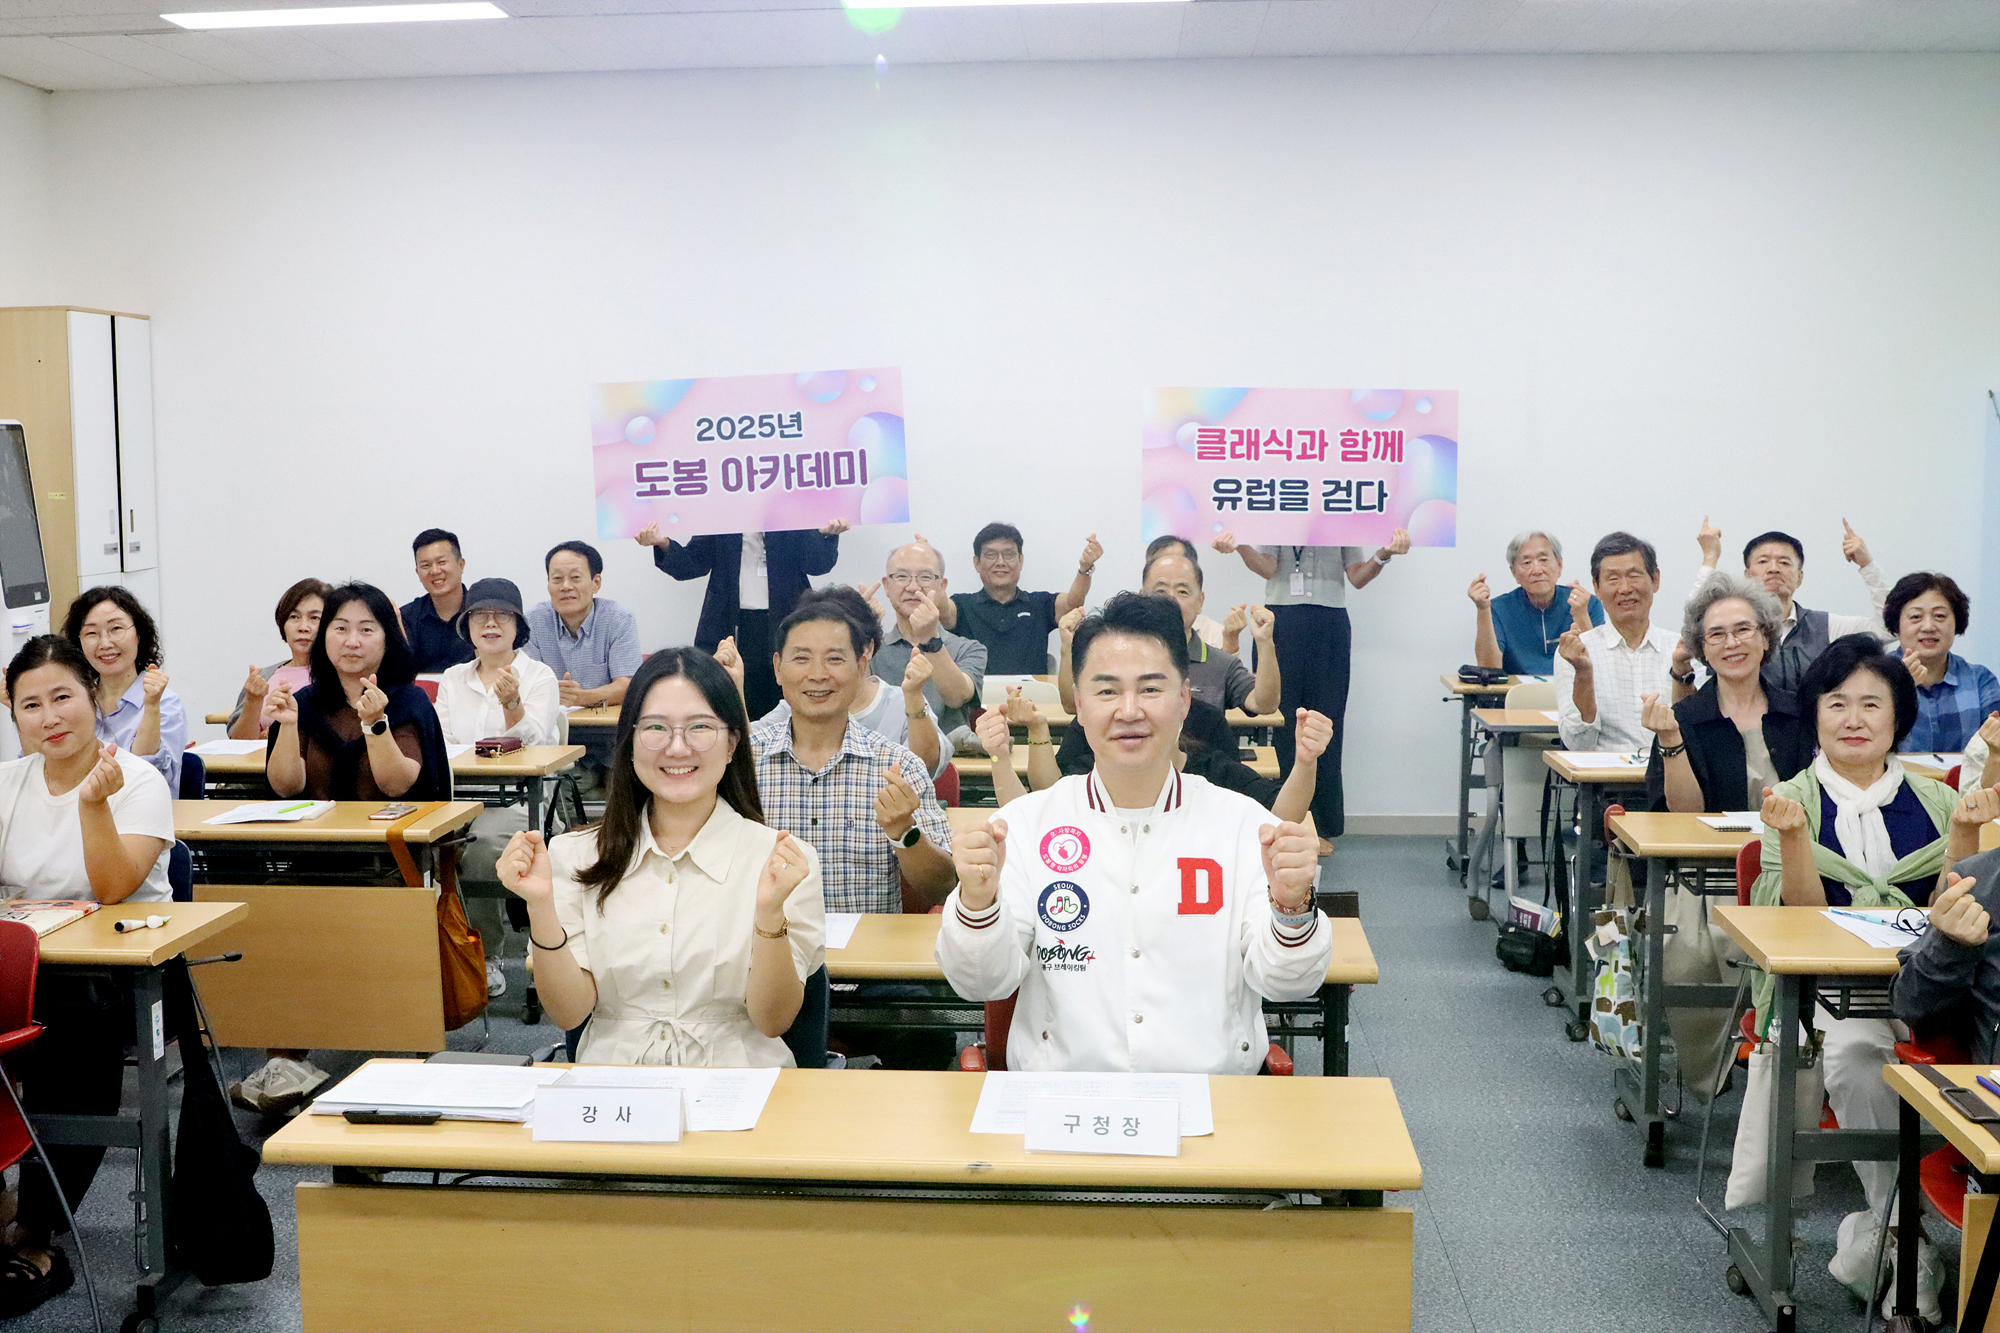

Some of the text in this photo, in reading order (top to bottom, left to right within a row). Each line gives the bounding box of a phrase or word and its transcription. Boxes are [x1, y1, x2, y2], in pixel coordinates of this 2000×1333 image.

[696, 411, 804, 442] 2025년
[1196, 427, 1404, 464] 클래식과 함께
[634, 448, 868, 498] 도봉 아카데미
[1212, 478, 1389, 513] 유럽을 걷다
[1052, 882, 1074, 891] SEOUL
[1177, 857, 1224, 916] D
[1041, 913, 1086, 931] DOBONG SOCKS
[1053, 963, 1087, 972] 브레이킹팀
